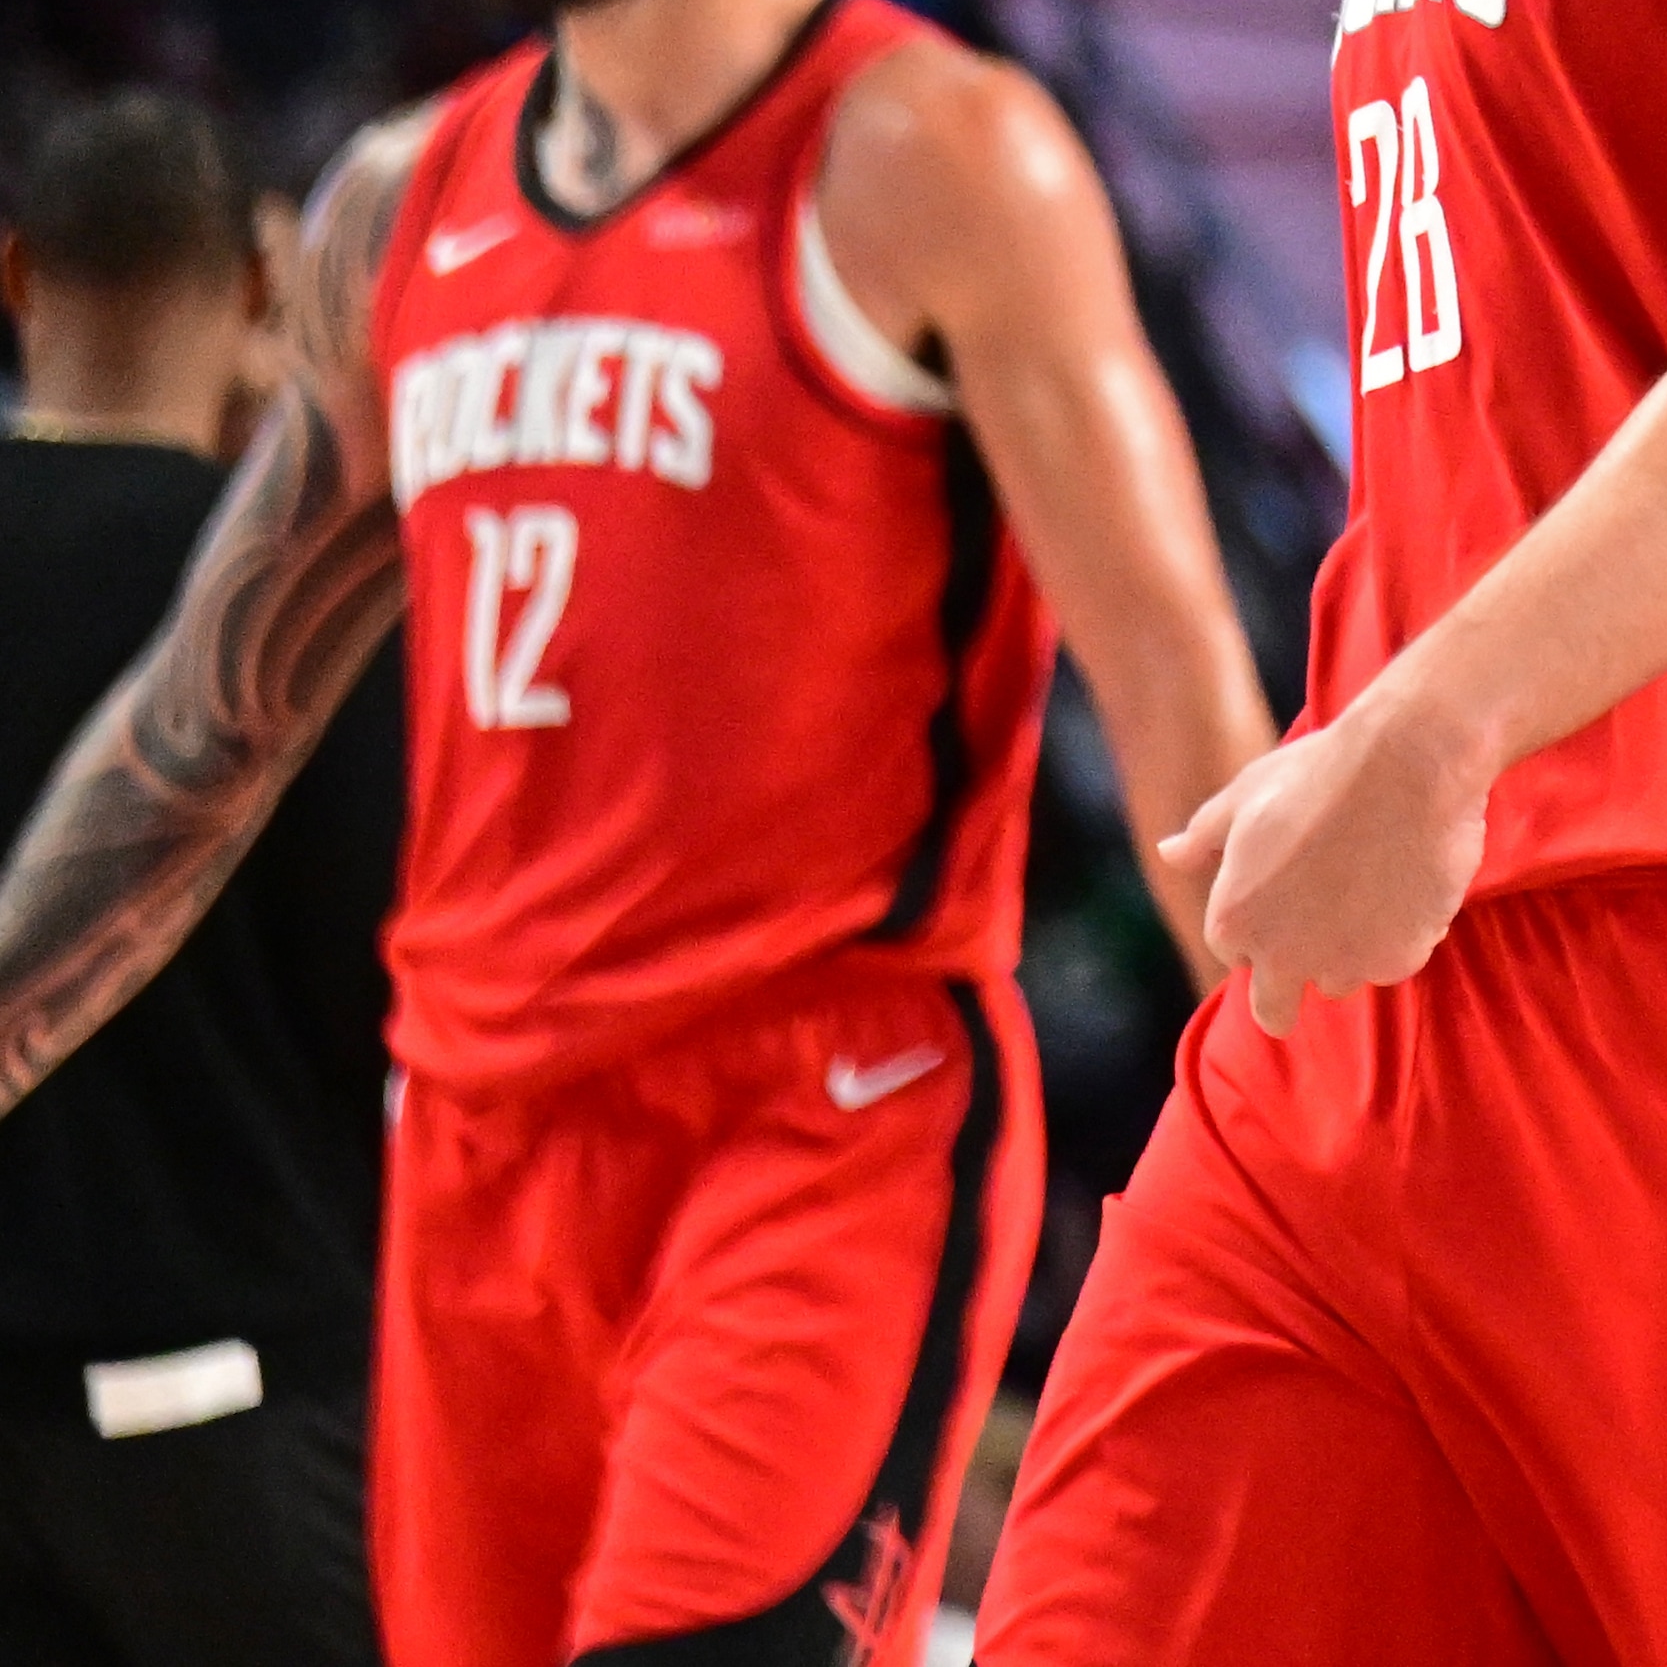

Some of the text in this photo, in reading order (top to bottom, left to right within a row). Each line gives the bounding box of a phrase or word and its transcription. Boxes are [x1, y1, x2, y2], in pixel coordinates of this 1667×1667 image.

[1347, 76, 1462, 398] 28
[390, 315, 725, 516] ROCKETS
[462, 501, 580, 731] 12
